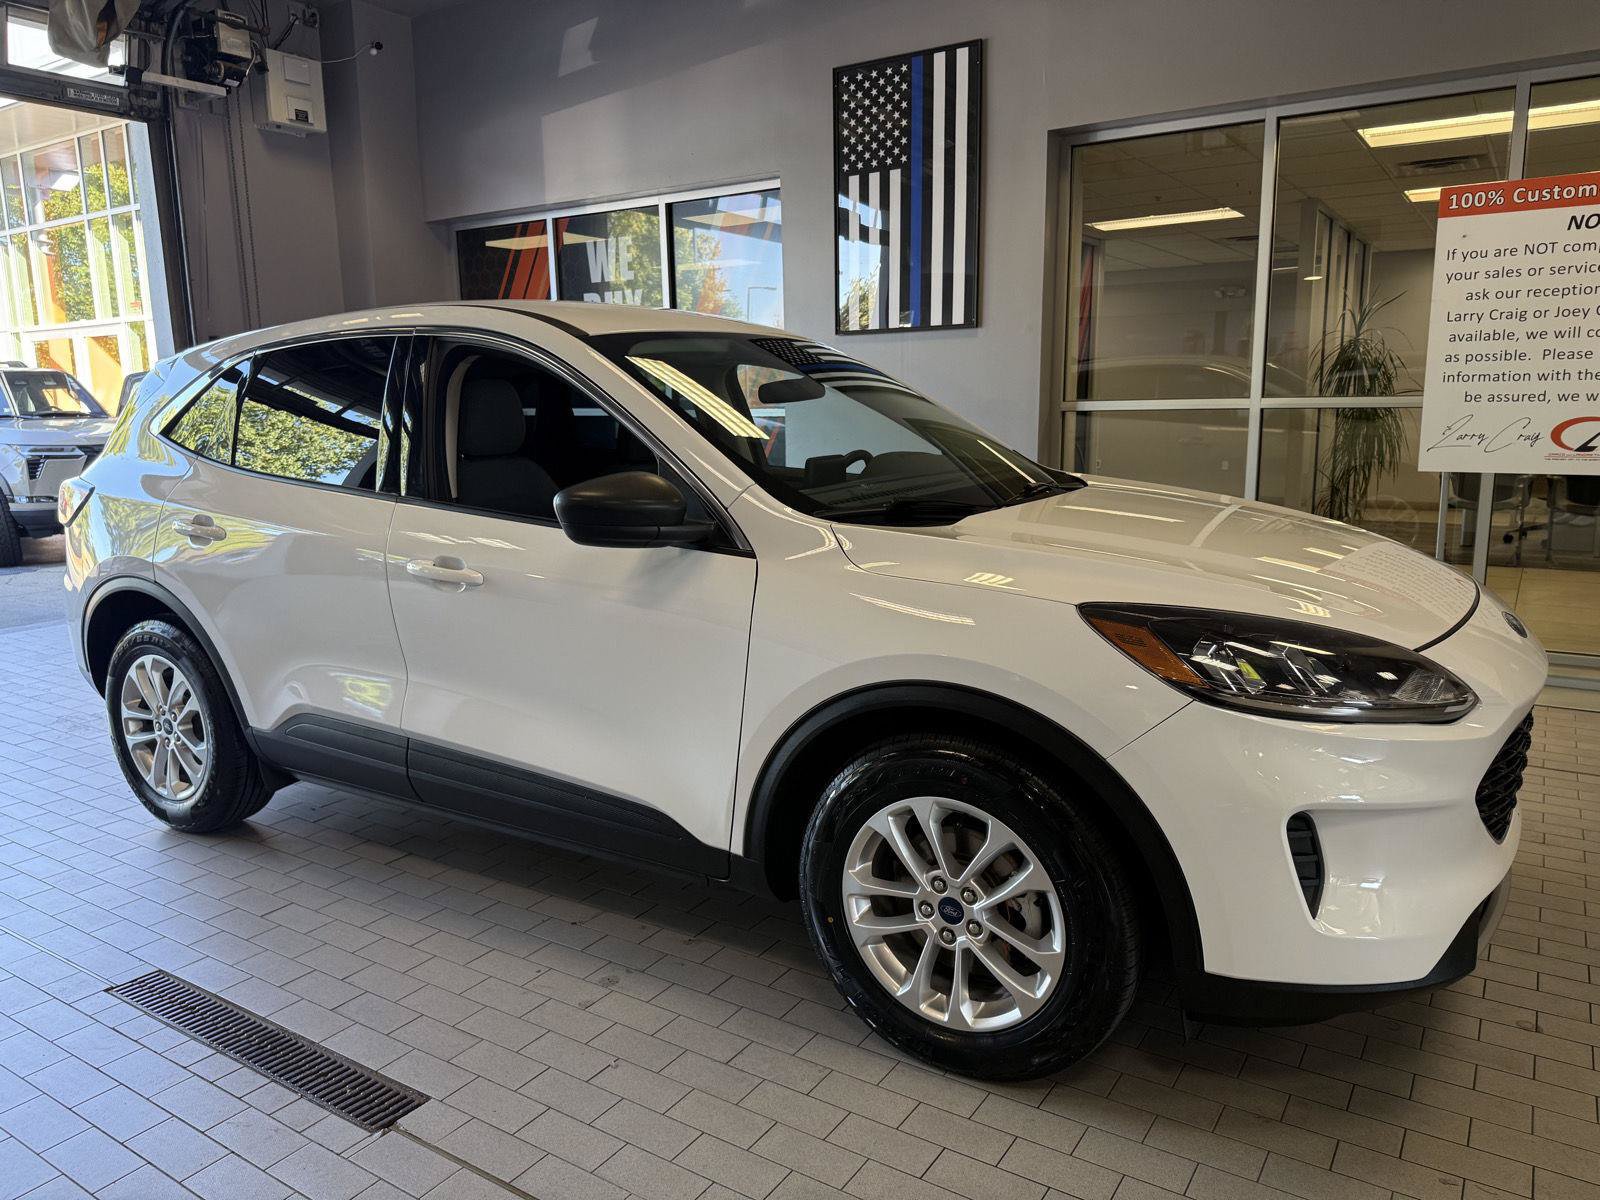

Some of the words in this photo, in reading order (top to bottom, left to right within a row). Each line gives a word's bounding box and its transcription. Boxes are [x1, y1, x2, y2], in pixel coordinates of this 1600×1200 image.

[1448, 189, 1505, 211] 100%
[1513, 183, 1600, 203] Custom
[586, 235, 635, 283] WE
[1446, 249, 1457, 261] If
[1462, 250, 1488, 262] you
[1494, 247, 1518, 258] are
[1524, 242, 1558, 256] NOT
[1563, 241, 1600, 253] com
[1446, 271, 1480, 284] your
[1484, 266, 1522, 279] sales
[1528, 266, 1544, 277] or
[1465, 288, 1490, 301] ask
[1495, 289, 1522, 300] our
[1446, 311, 1484, 324] Larry
[1489, 308, 1527, 322] Craig
[1533, 309, 1550, 319] or
[1554, 306, 1590, 319] Joey
[1448, 329, 1520, 343] available,
[1526, 330, 1548, 340] we
[1554, 326, 1581, 339] will
[1445, 354, 1460, 363] as
[1465, 350, 1531, 364] possible.
[1543, 349, 1593, 360] Please
[1442, 371, 1531, 383] information
[1538, 370, 1571, 381] with
[1464, 391, 1482, 403] be
[1488, 390, 1551, 404] assured,
[1558, 392, 1580, 402] we
